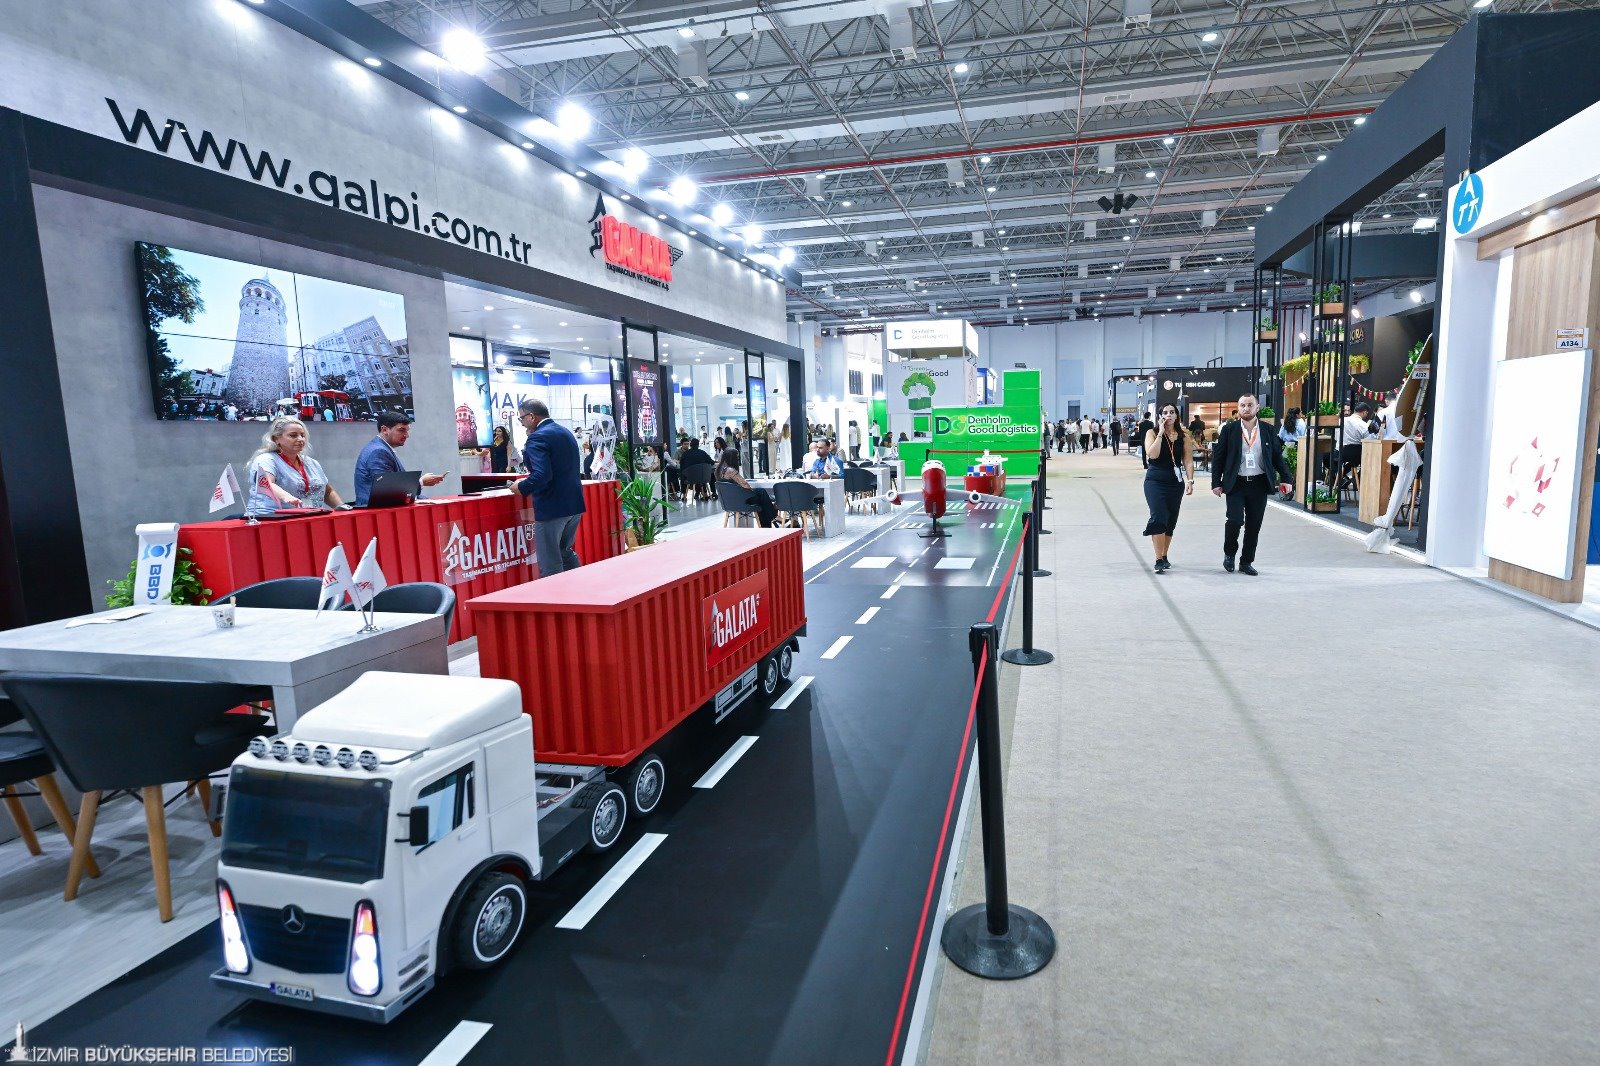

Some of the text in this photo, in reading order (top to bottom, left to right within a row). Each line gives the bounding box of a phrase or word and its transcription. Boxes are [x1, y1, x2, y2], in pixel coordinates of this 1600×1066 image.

[105, 97, 532, 265] www.galpi.com.tr
[968, 415, 1010, 424] Denholm
[968, 425, 1037, 435] Good Logistics
[458, 525, 528, 571] GALATA
[716, 594, 758, 648] GALATA
[277, 985, 311, 998] GALATA
